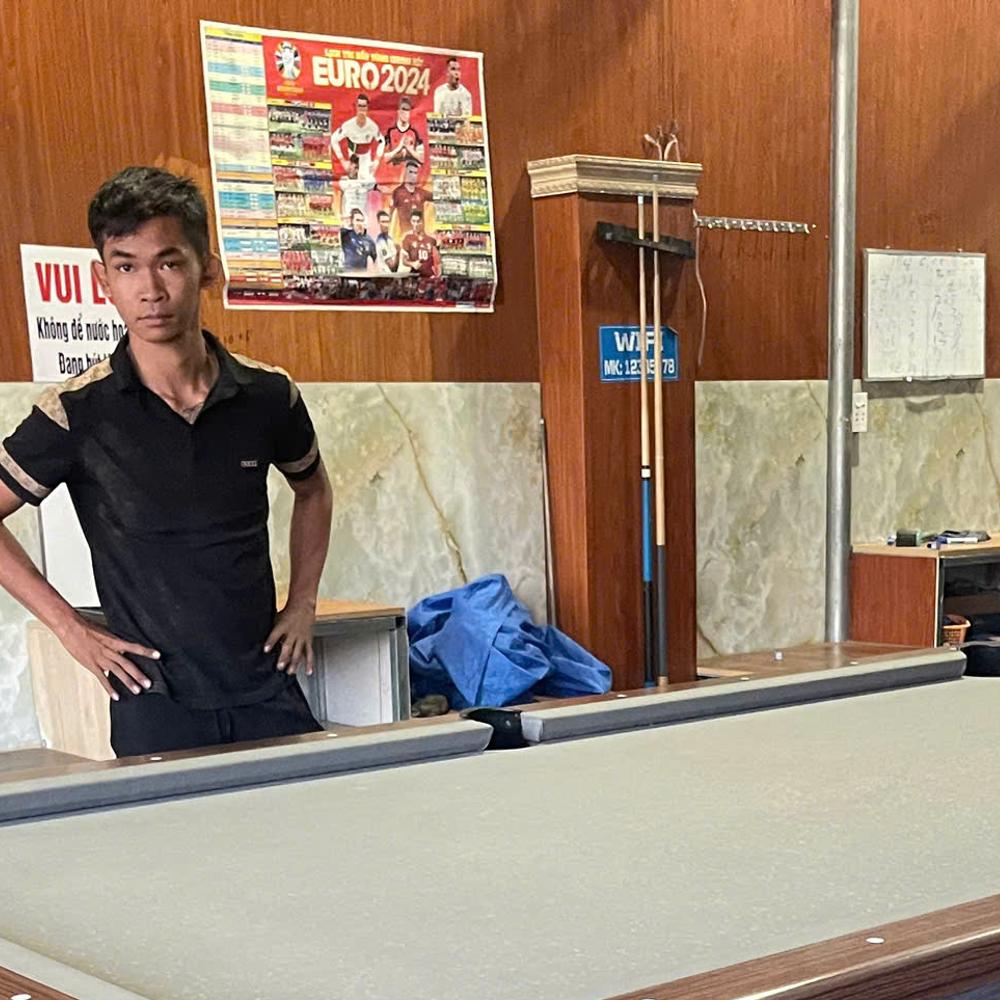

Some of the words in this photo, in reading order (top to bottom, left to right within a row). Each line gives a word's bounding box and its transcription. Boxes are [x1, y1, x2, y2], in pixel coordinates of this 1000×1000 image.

[35, 262, 82, 304] VUI
[37, 316, 68, 343] Không
[71, 312, 84, 341] để
